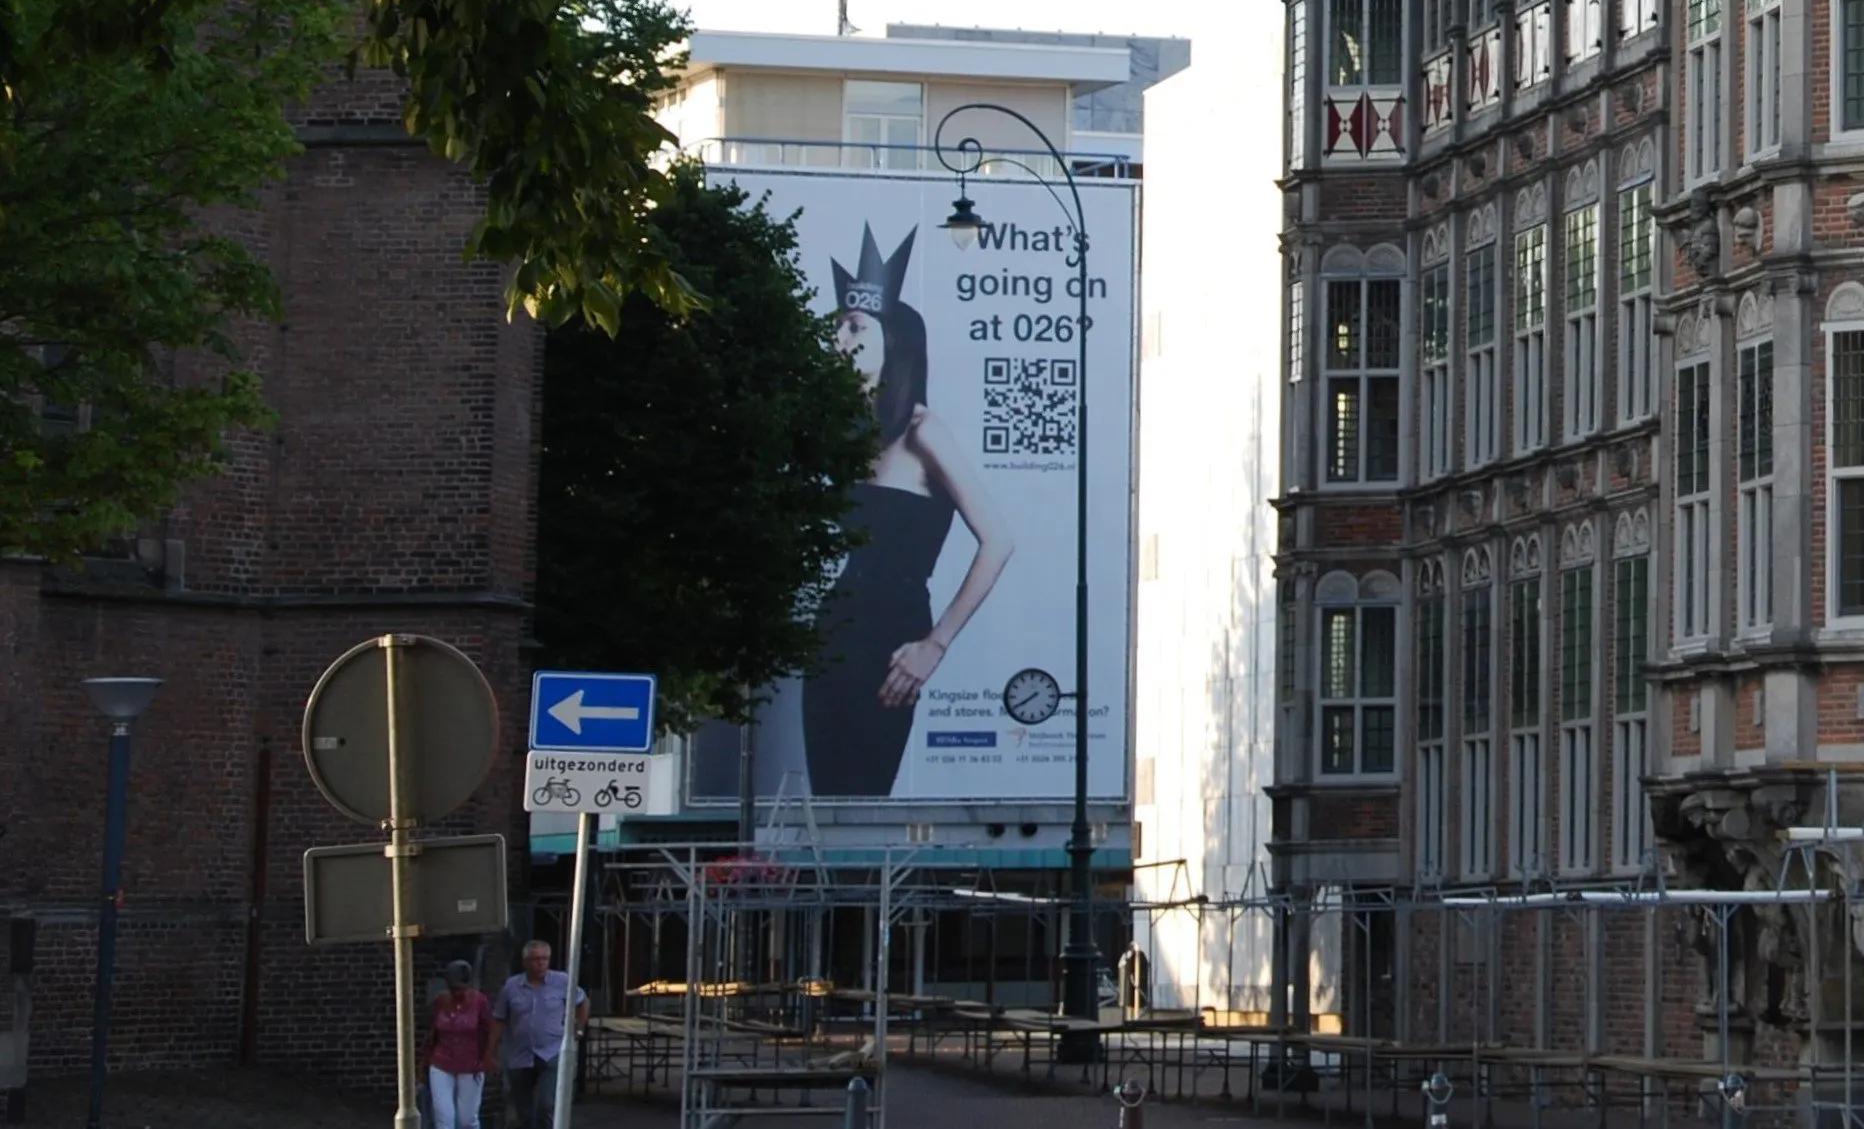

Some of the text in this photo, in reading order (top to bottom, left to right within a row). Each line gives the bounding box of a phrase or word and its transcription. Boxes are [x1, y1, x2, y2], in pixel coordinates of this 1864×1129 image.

[977, 222, 1090, 253] What's
[956, 268, 1107, 304] going on
[845, 290, 882, 312] 026
[969, 315, 1002, 342] at
[928, 688, 979, 704] Kingsize
[928, 705, 951, 718] and
[954, 706, 994, 718] stores.
[534, 757, 645, 774] uitgezonderd
